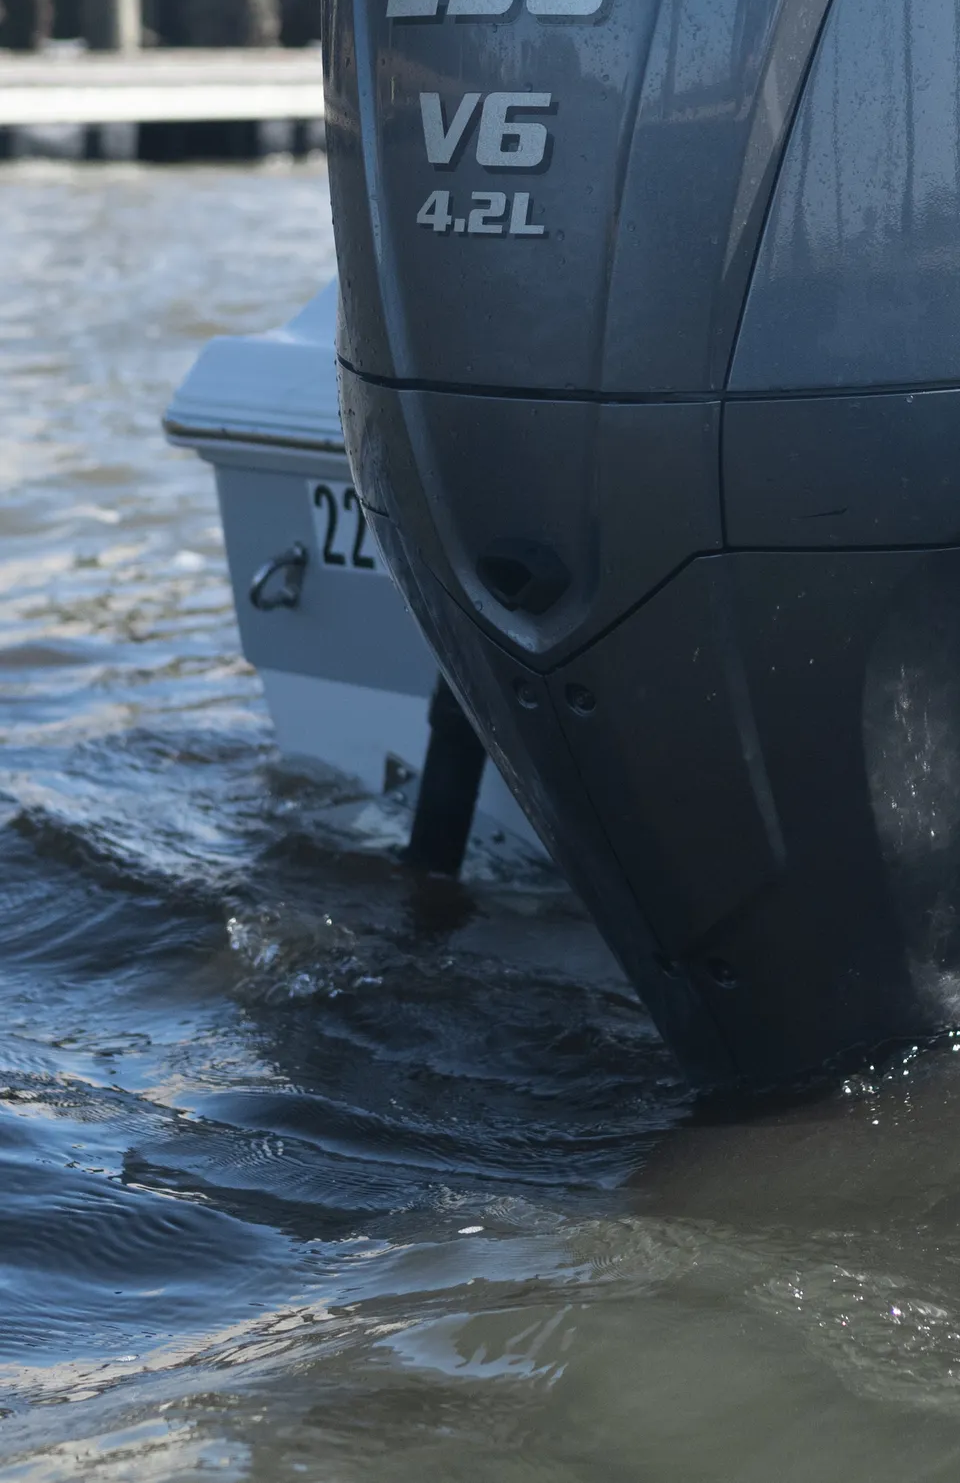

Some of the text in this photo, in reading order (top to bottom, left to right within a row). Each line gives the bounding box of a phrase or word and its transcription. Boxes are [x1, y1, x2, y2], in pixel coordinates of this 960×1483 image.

[419, 91, 552, 167] V6
[416, 190, 545, 235] 4.2L
[314, 484, 375, 568] 22
